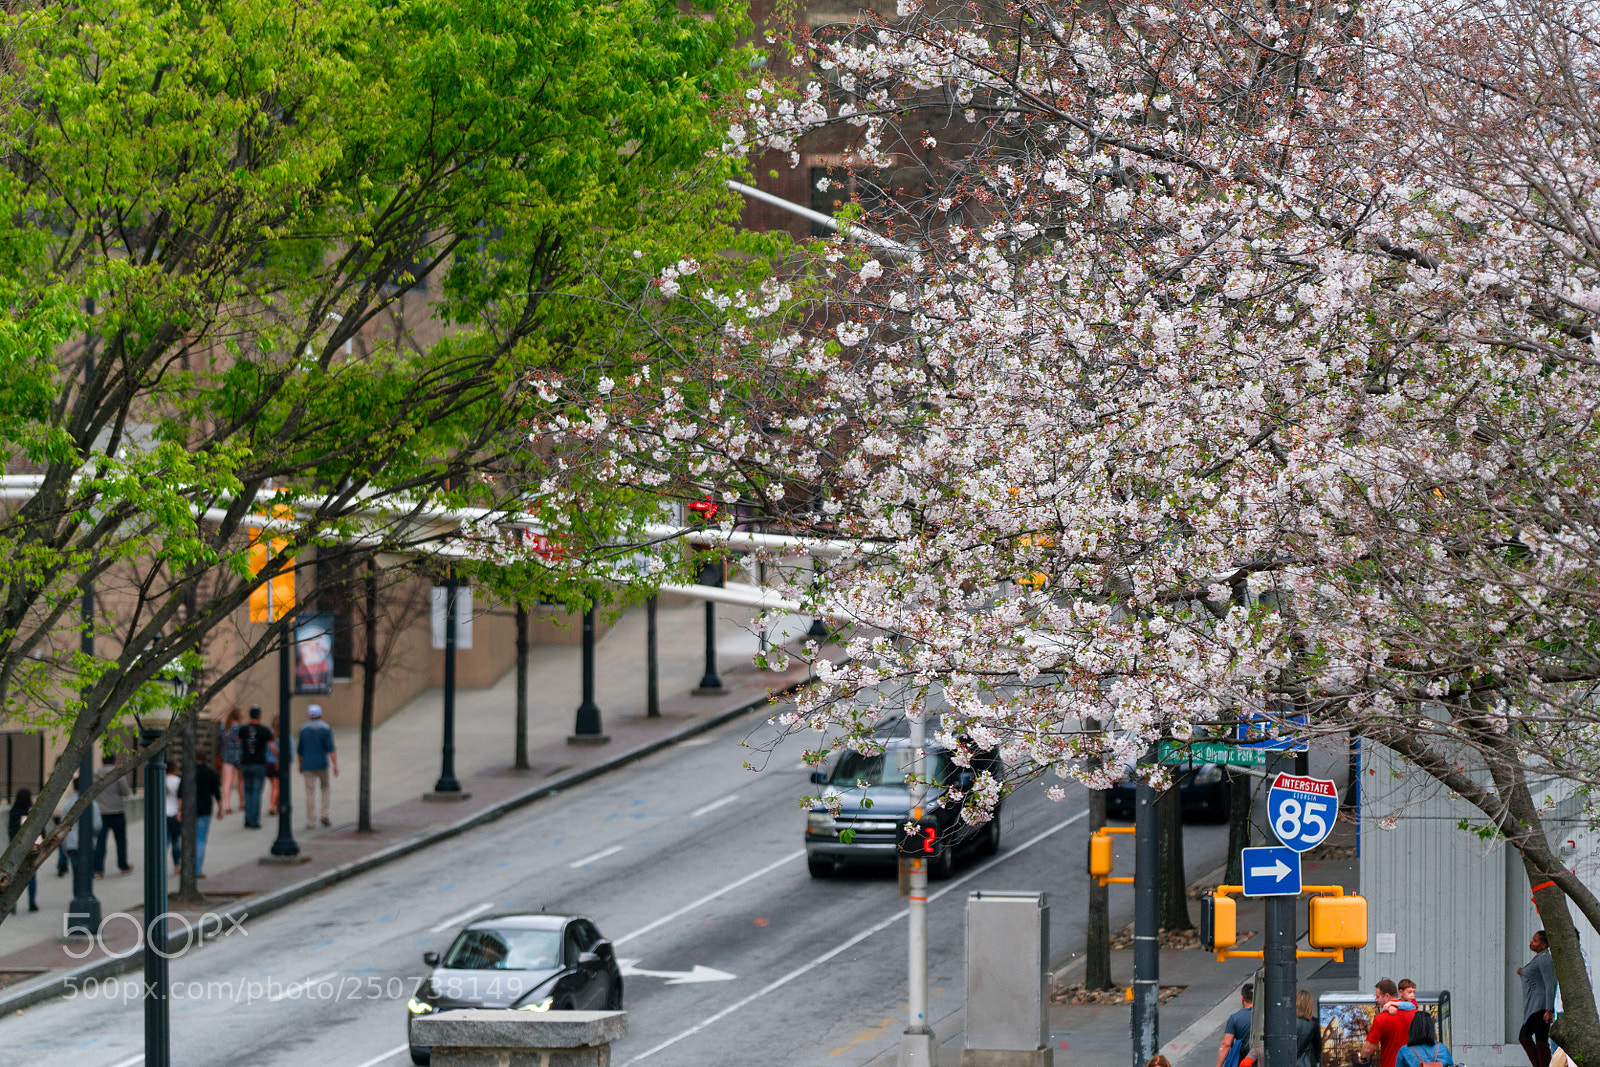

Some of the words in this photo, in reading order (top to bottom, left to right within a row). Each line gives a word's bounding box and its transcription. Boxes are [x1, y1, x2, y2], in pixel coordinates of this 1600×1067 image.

[1206, 746, 1234, 764] Olympic
[1238, 749, 1254, 761] Park
[1281, 778, 1330, 794] INTERSTATE
[1293, 792, 1317, 802] GEORGIA
[1275, 798, 1328, 844] 85
[923, 827, 935, 852] 2
